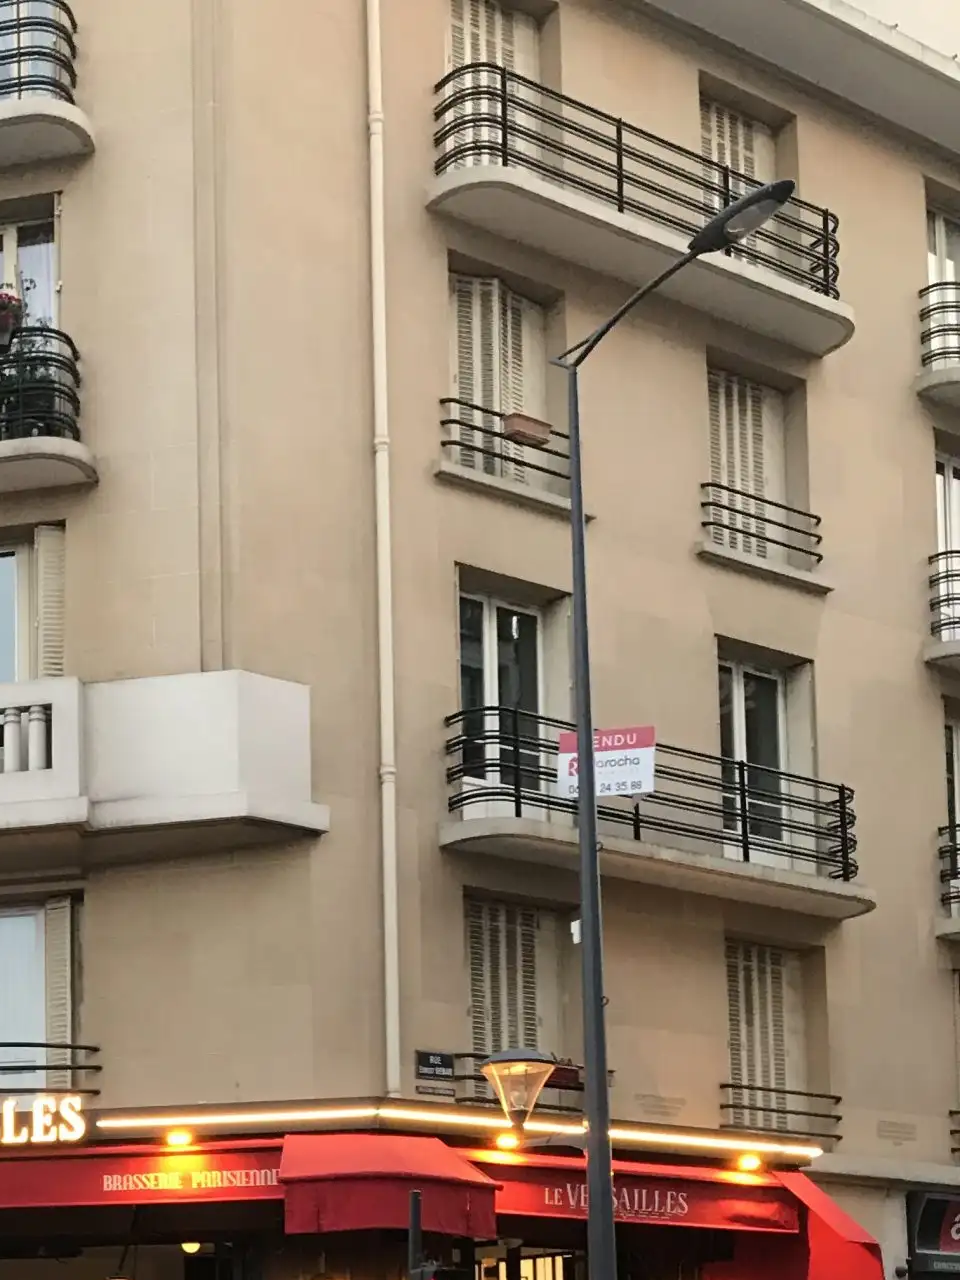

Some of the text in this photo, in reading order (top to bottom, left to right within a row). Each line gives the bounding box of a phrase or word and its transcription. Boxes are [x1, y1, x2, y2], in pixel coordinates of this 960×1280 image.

[592, 733, 637, 748] ENDU
[599, 783, 611, 793] 24
[102, 1172, 183, 1192] BRASSERIE
[544, 1183, 689, 1215] LE VESAILLES
